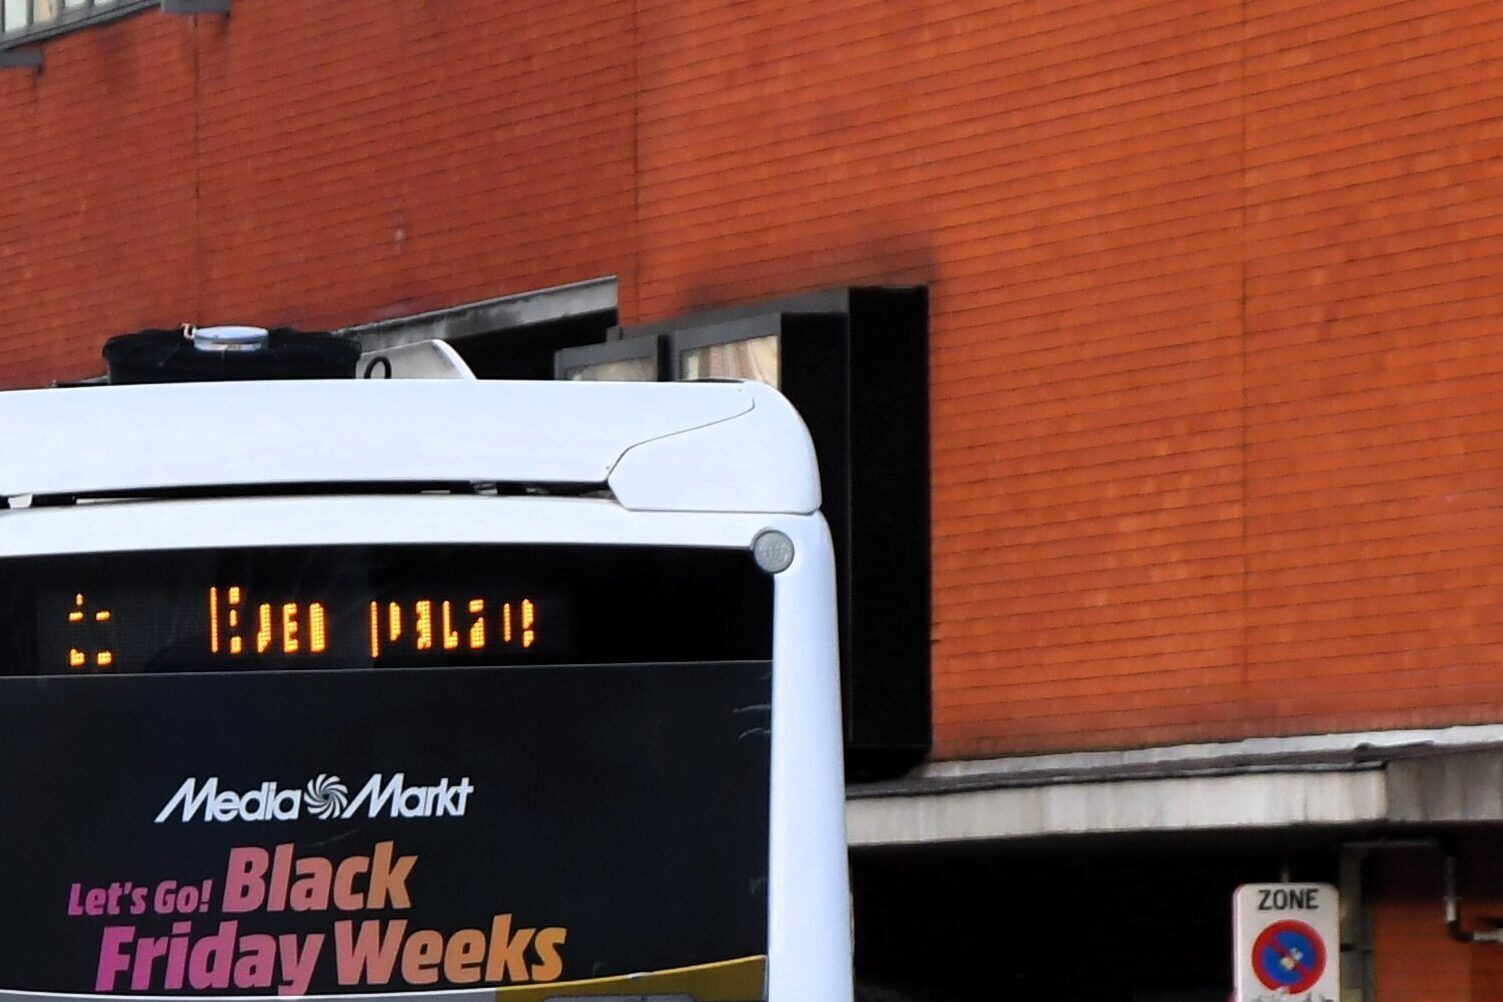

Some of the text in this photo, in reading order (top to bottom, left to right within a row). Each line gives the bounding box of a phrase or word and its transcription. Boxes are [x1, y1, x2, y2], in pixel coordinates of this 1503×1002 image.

[154, 772, 475, 823] Media Markt
[67, 840, 419, 916] Let's Go! Black
[1257, 888, 1319, 911] ZONE
[95, 913, 568, 1001] Friday Weeks
